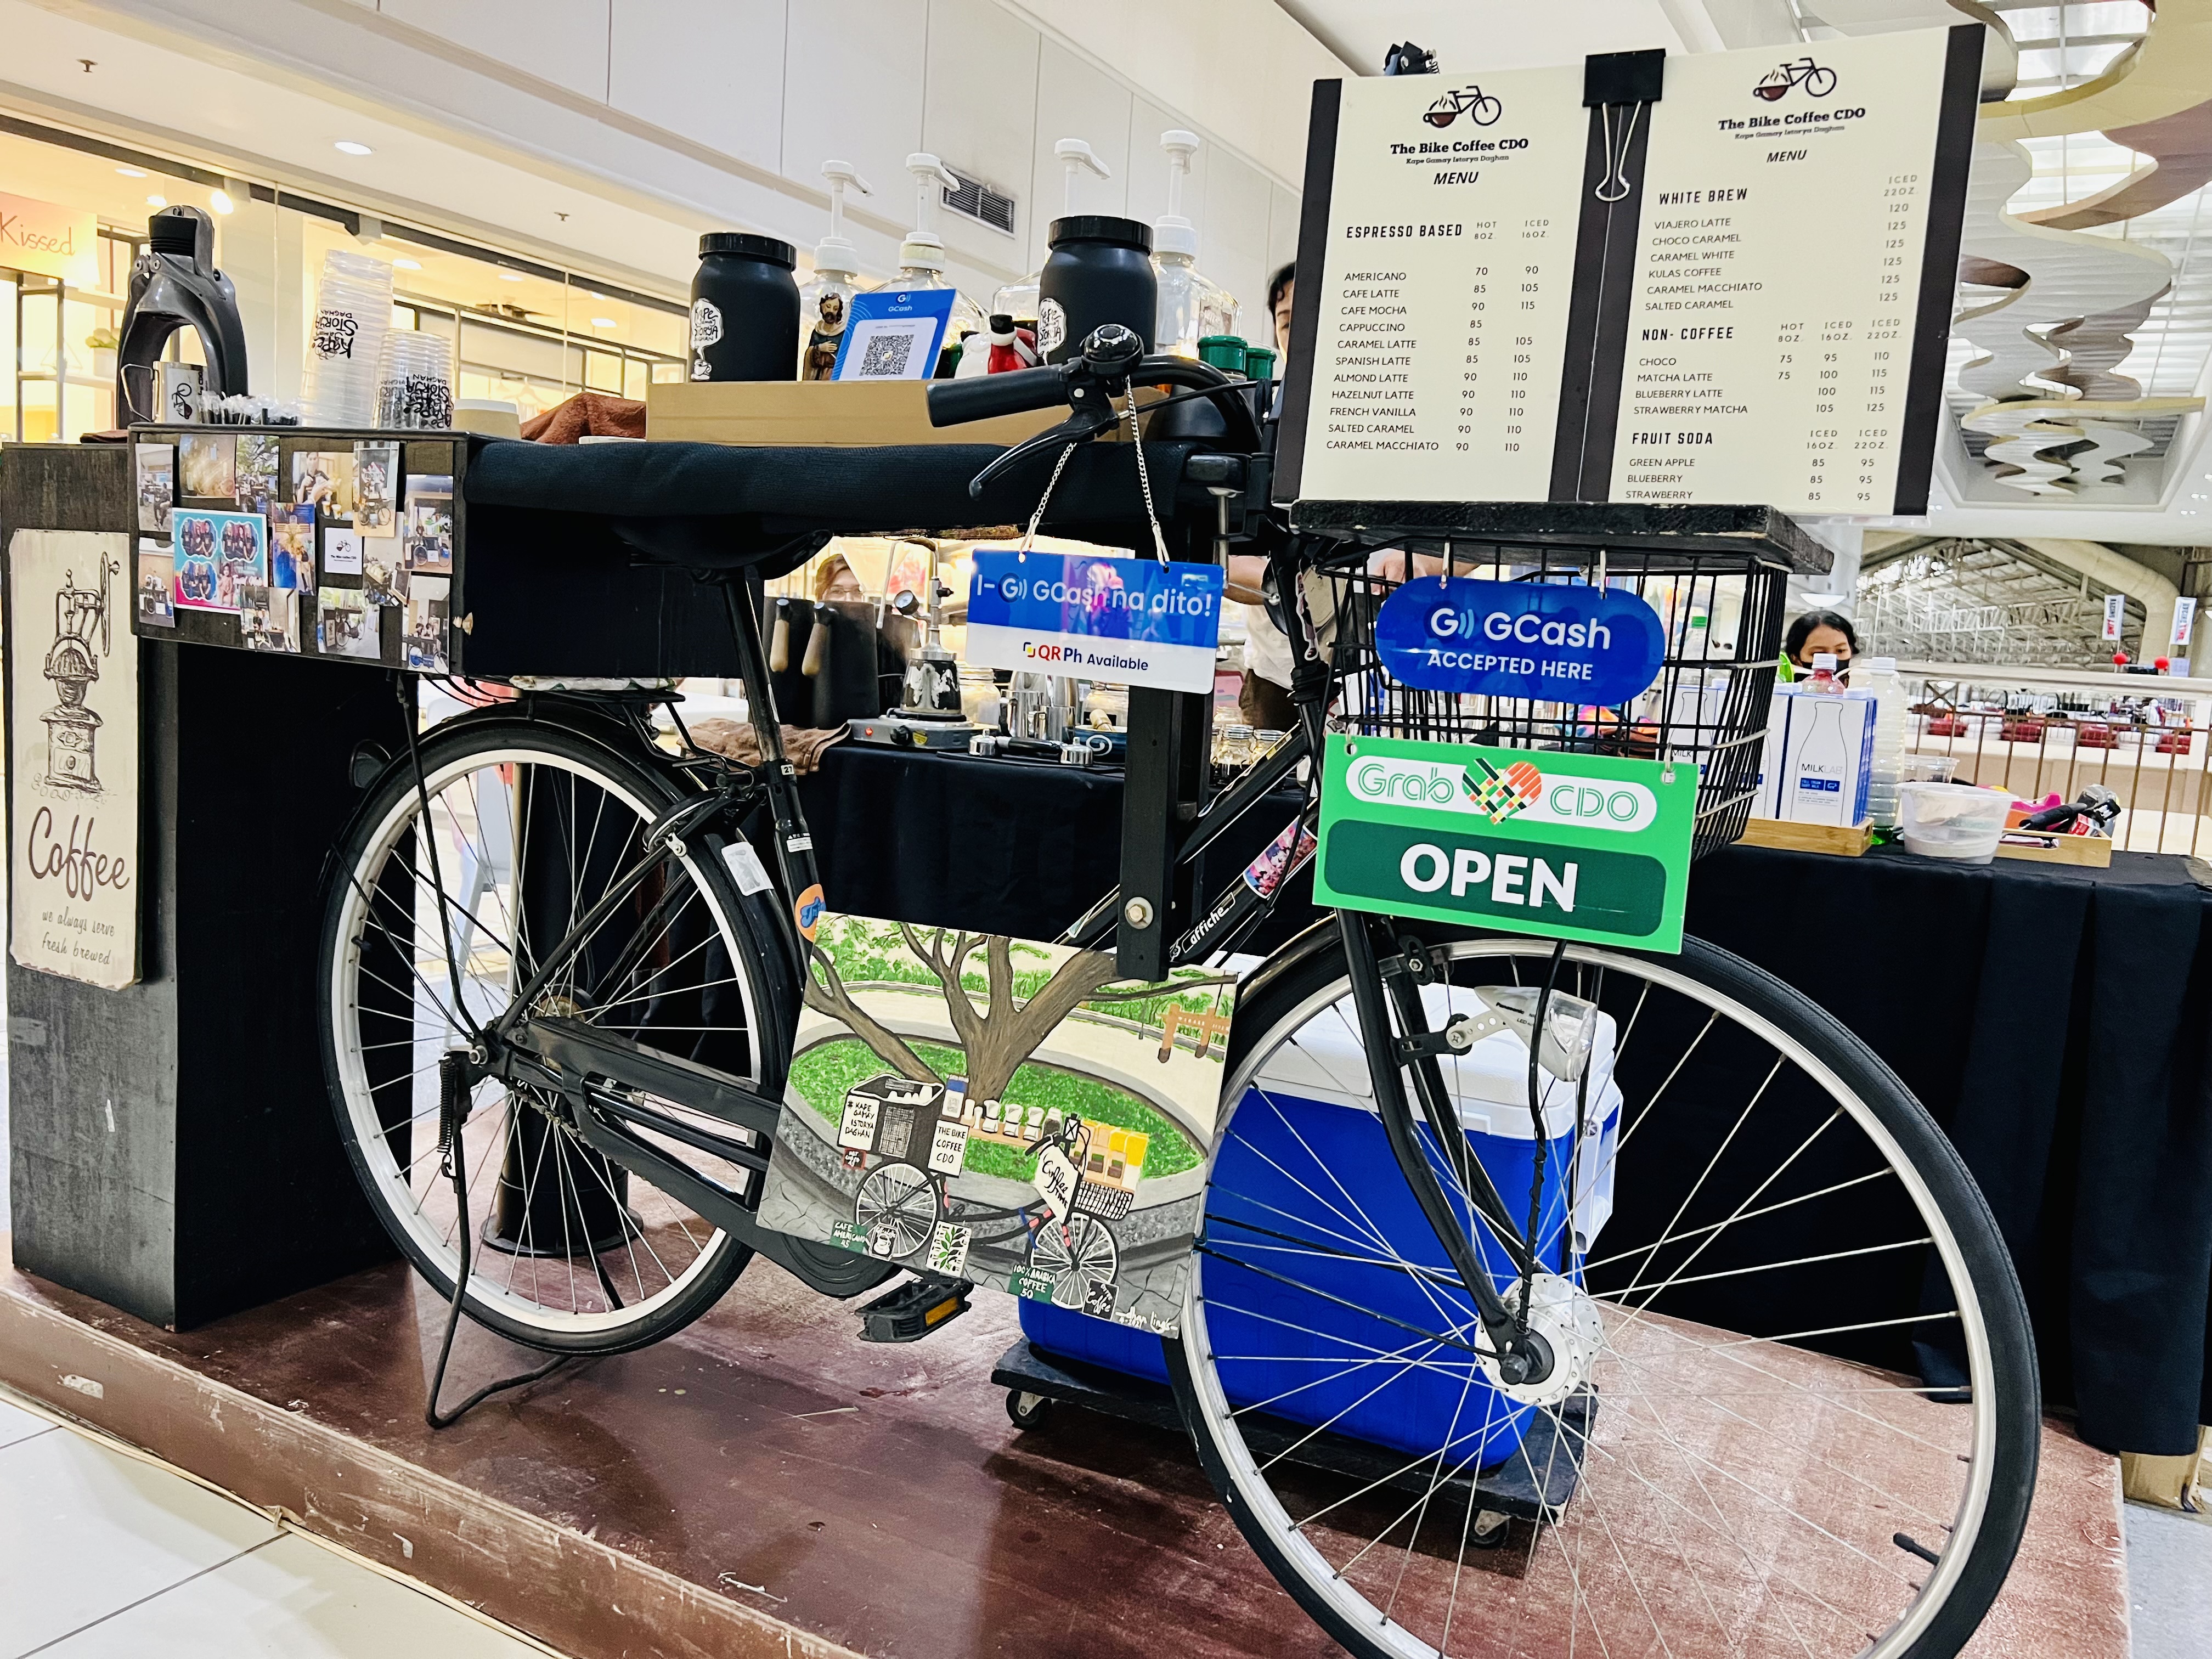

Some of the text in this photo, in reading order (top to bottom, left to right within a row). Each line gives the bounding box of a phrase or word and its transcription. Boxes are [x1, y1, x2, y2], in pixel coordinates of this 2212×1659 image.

[1718, 108, 1866, 131] The Bike Coffee CDO
[1390, 138, 1529, 155] The Bike Coffee CDO
[1766, 149, 1808, 163] MENU
[1433, 171, 1479, 185] MENU
[1660, 188, 1747, 205] WHITE BREW
[1654, 203, 1909, 229] VIAJERO LATTE 120
[0, 211, 75, 256] Kissed
[1346, 224, 1462, 238] ESPRESSO BASED
[1652, 221, 1906, 246] CHOCO CARAMEL 125
[1650, 239, 1904, 262] CARAMEL WHITE 125
[1344, 266, 1538, 281] AMERICANO 70 90
[1649, 257, 1902, 278] KULAS COFFEE 125
[1342, 283, 1538, 298] CAFE LATTE 85 105
[1647, 274, 1900, 295] CARAMEL MACCHIATO 125
[1341, 301, 1535, 315] CAFE MOCHA 90 115
[1645, 292, 1898, 311] SALTED CARAMEL 125
[1339, 320, 1482, 332] CAPPUCCINO 85
[1642, 326, 1734, 341] NON- COFFEE
[1338, 336, 1533, 349] CARAMEL LATTE 85 105
[1335, 354, 1531, 365] SPANISH LATTE 85 105
[1639, 352, 1889, 366] CHOCO 75 95 110
[413, 374, 447, 385] DAGHAN
[1333, 372, 1527, 382] ALMOND LATTE 90 110
[1637, 369, 1887, 382] MATCHA LATTE 75 100 115
[1331, 390, 1526, 399] HAZELNUT LATTE 90 110
[1635, 386, 1885, 398] BLUEBERRY LATTE 100 115
[1330, 407, 1523, 416] FRENCH VANILLA 90 110
[1633, 403, 1884, 415] STRAWBERRY MATCHA 105 125
[1328, 424, 1522, 434] SALTED CARAMEL 90 110
[1632, 432, 1712, 444] FRUIT SODA
[1327, 441, 1520, 452] CARAMEL MACCHIATO 90 110
[1629, 458, 1875, 467] GREEN APPLE 85 95
[1627, 475, 1872, 484] BLUEBERRY 85 95
[1626, 490, 1870, 501] STRAWBERRY 85 95
[1032, 580, 1107, 606] GCash
[1111, 588, 1144, 611] na
[1152, 588, 1211, 618] dito!
[1483, 611, 1611, 650] GCash
[1038, 644, 1149, 671] QR Ph Available
[1427, 652, 1594, 681] ACCEPTED HERE
[1357, 763, 1639, 822] Grab CDO
[28, 805, 130, 902] Coffee
[1400, 843, 1579, 913] OPEN
[42, 906, 115, 937] we always serve
[1190, 906, 1229, 945] affiche
[42, 931, 112, 966] fresh brewed
[851, 1119, 874, 1130] ISTORYA
[845, 1126, 871, 1139] DAGHAN
[937, 1126, 967, 1140] THE BIKE
[936, 1139, 962, 1153] COFFEE
[936, 1152, 955, 1164] CDO
[1042, 1154, 1069, 1194] Coffee
[834, 1221, 854, 1232] CAFE
[833, 1229, 866, 1243] AMERICANO
[1018, 1277, 1048, 1294] COFFEE
[1019, 1288, 1034, 1299] 50
